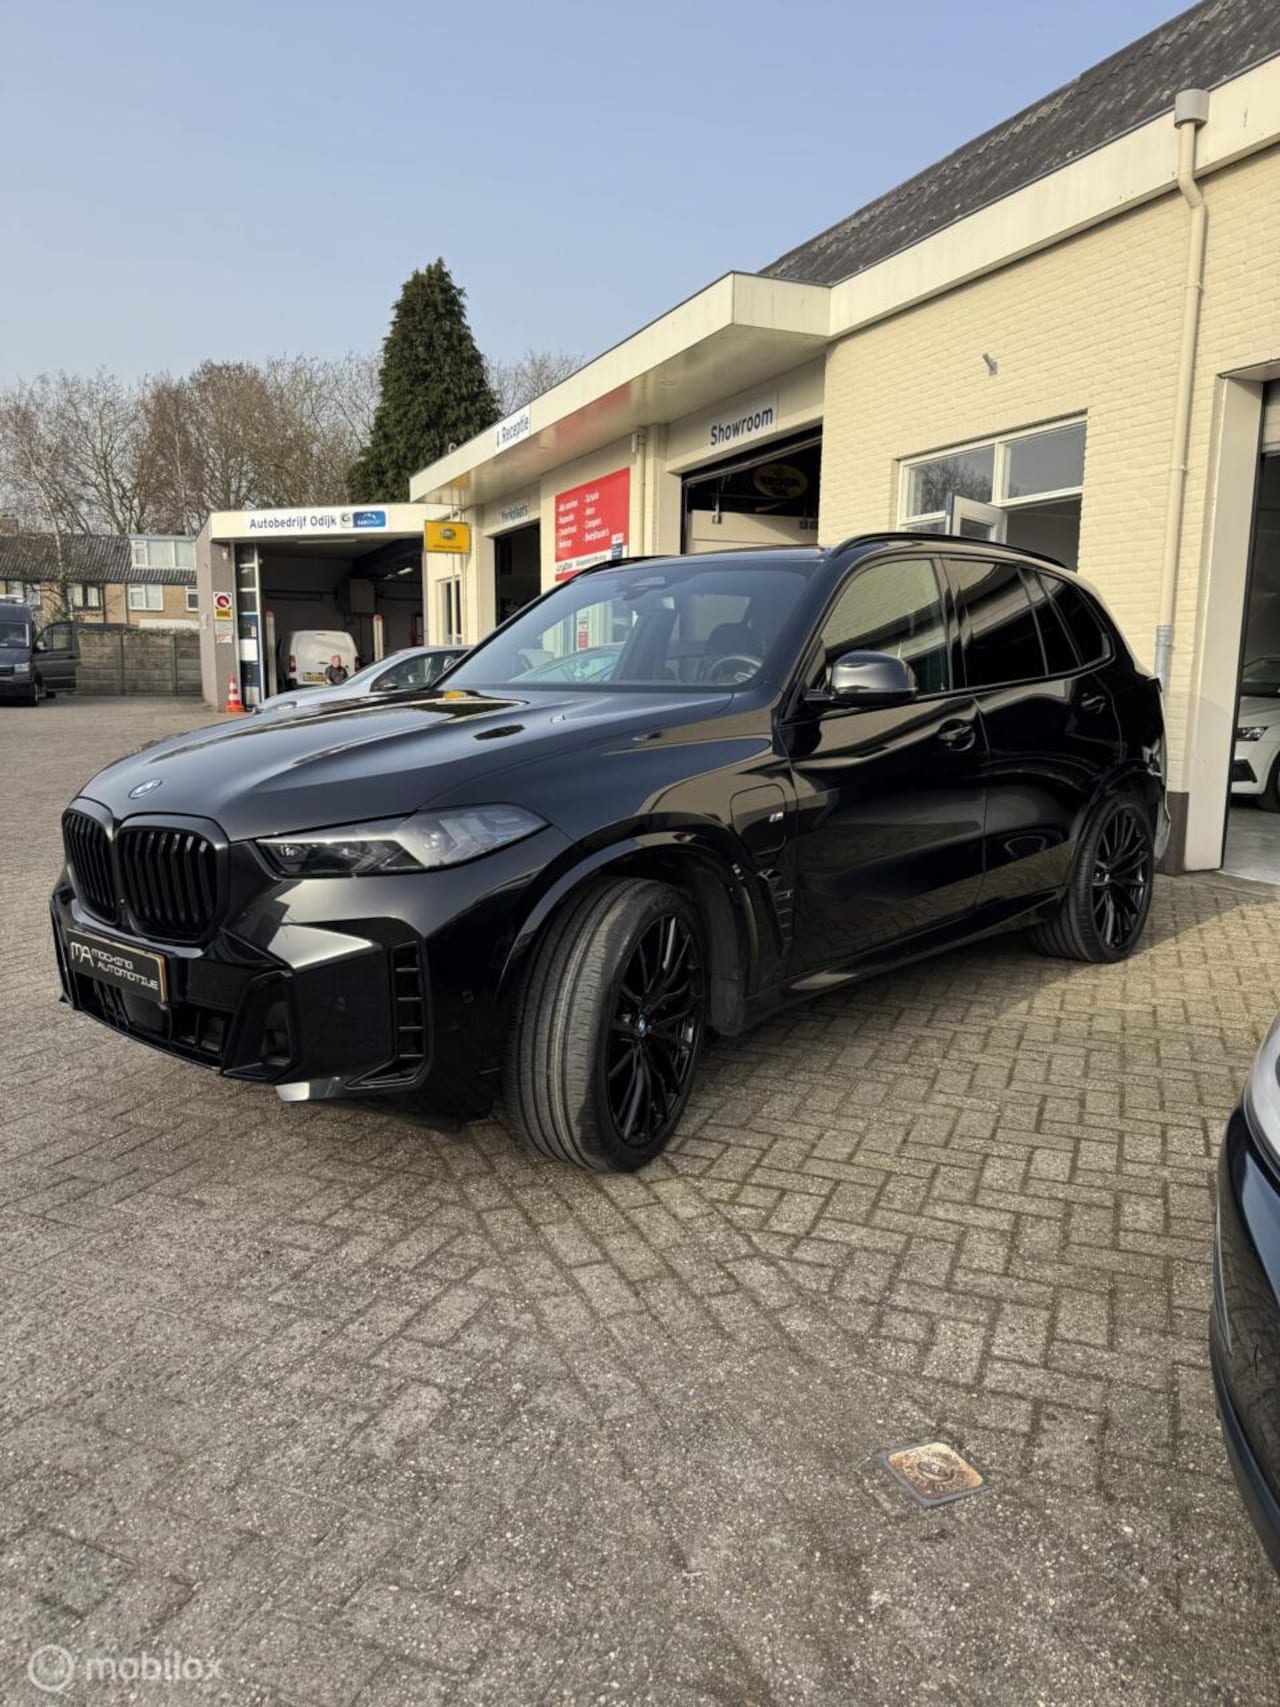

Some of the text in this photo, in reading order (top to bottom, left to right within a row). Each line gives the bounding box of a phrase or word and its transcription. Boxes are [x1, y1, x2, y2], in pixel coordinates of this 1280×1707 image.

[502, 414, 529, 443] Receptie
[710, 407, 773, 446] Showroom
[249, 515, 337, 529] Autobedrijf Odijk
